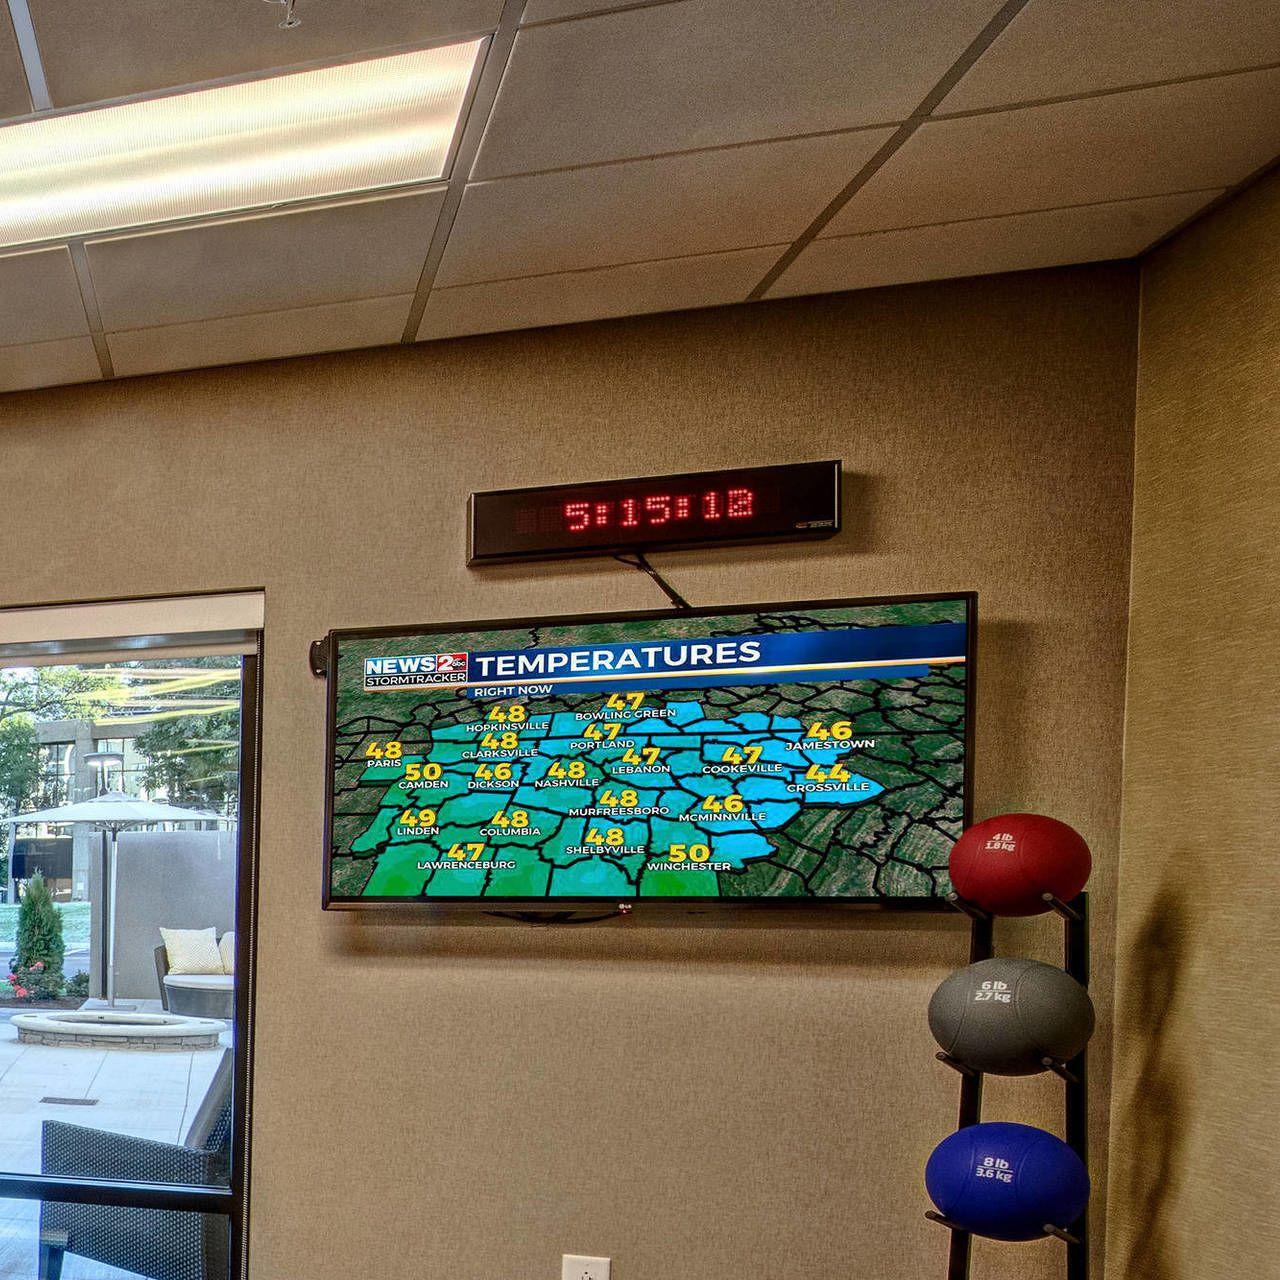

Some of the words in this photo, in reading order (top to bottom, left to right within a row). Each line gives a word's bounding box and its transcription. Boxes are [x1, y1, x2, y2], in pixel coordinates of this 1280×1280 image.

[475, 640, 762, 677] TEMPERATURES
[366, 655, 435, 675] NEWS
[366, 673, 466, 686] STORMTRACKER
[474, 686, 516, 698] RIGHT
[517, 684, 553, 695] NOW
[607, 692, 645, 711] 47
[489, 705, 526, 723] 48
[575, 710, 632, 721] BOWLING
[634, 709, 676, 719] GREEN
[466, 722, 550, 732] HOPKINSVILLE
[583, 723, 622, 741] 47
[807, 720, 853, 740] 46
[481, 732, 519, 750] 48
[570, 740, 635, 750] PORTLAND
[785, 740, 876, 751] JAMESTOWN
[365, 741, 403, 760] 48
[462, 749, 539, 759] CLARKSVILLE
[622, 747, 661, 765] 47
[722, 746, 763, 765] 47
[367, 760, 402, 768] PARIS
[548, 761, 586, 779] 48
[612, 765, 671, 775] LEBANON
[702, 763, 783, 774] COOKEVILLE
[405, 763, 443, 781] 50
[474, 762, 512, 780] 46
[805, 763, 852, 783] 44
[398, 780, 449, 789] CAMDEN
[467, 780, 520, 789] DICKSON
[534, 779, 600, 788] NASHVILLE
[786, 782, 870, 792] CROSSVILLE
[599, 789, 639, 808] 48
[702, 794, 744, 812] 46
[569, 807, 670, 816] MURFREESBORO
[679, 812, 767, 822] MCMINNVILLE
[399, 809, 436, 828] 49
[491, 810, 529, 829] 48
[397, 827, 440, 836] LINDEN
[479, 828, 541, 836] COLUMBIA
[585, 828, 625, 846] 48
[992, 833, 1001, 841] 4
[1001, 833, 1013, 841] lb
[447, 843, 485, 862] 47
[566, 845, 645, 855] SHELBYVILLE
[1001, 842, 1016, 852] kg
[668, 844, 711, 863] 50
[417, 861, 516, 870] LAWRENCEBURG
[647, 862, 732, 872] WINCHESTER
[981, 981, 992, 990] 6
[993, 981, 1008, 990] lb
[975, 992, 993, 1001] 2.7
[994, 992, 1011, 1003] kg
[983, 1157, 995, 1167] 8
[995, 1158, 1009, 1169] lb
[976, 1167, 995, 1178] 3.6
[995, 1170, 1013, 1183] kg
